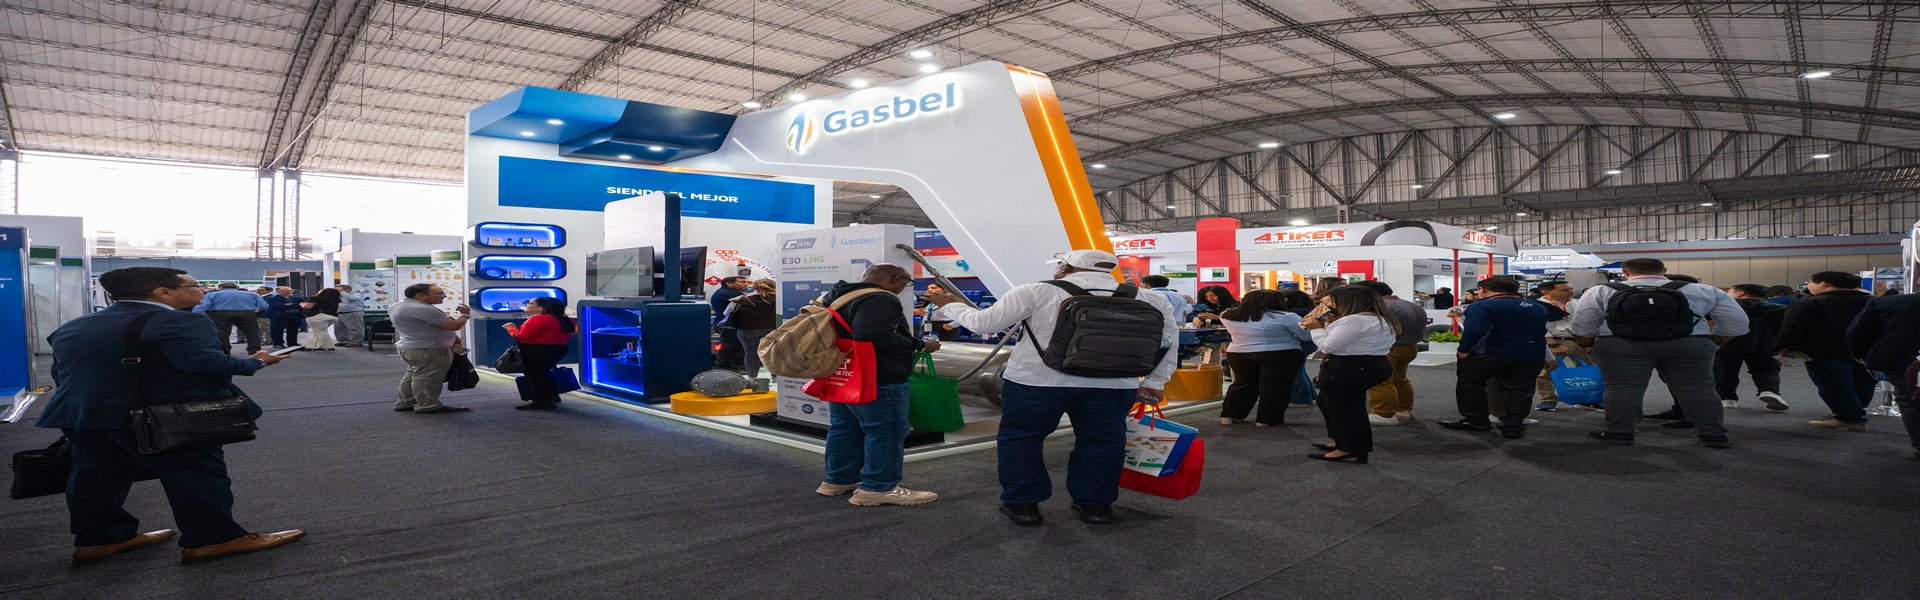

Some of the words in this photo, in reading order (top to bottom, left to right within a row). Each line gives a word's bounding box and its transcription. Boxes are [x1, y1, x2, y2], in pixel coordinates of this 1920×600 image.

[823, 82, 956, 133] Gasbel
[690, 192, 738, 203] MEJOR
[840, 237, 875, 246] Gasbel
[803, 255, 825, 264] LNG
